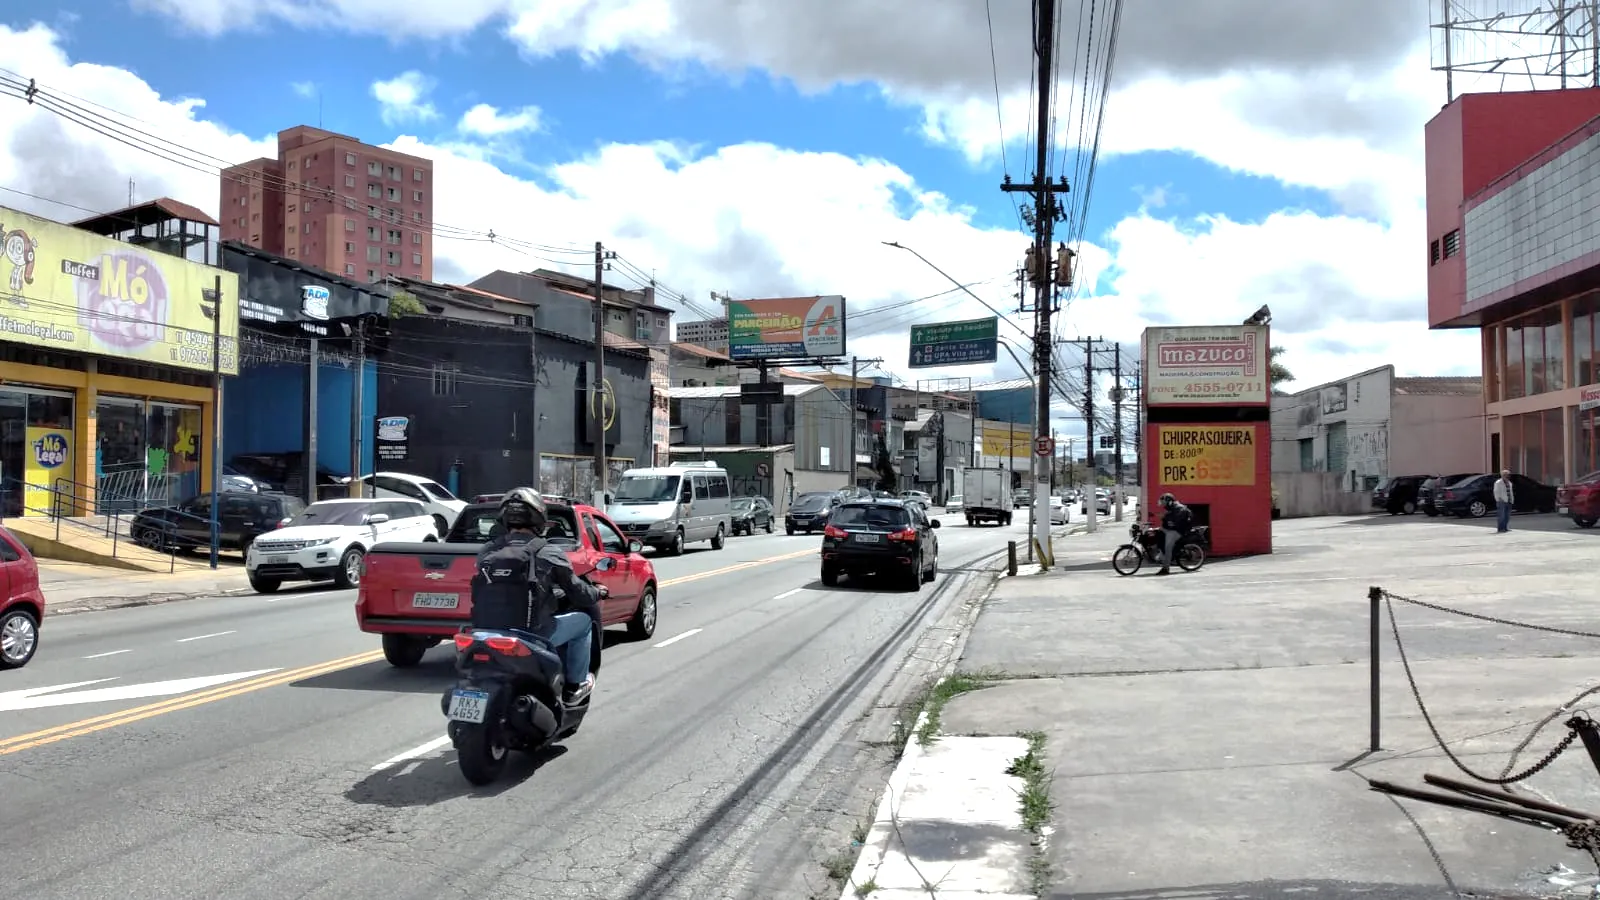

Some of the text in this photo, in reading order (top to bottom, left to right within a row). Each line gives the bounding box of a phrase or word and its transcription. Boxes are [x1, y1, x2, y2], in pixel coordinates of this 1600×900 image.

[64, 261, 97, 278] Buffet
[99, 254, 148, 305] Mó
[934, 351, 950, 359] UPA
[1163, 348, 1245, 362] mazuco
[1184, 382, 1262, 393] 4555-0711
[42, 435, 60, 452] Mó
[1163, 431, 1252, 446] CHURRASQUEIRA
[36, 446, 67, 465] Legal
[434, 598, 456, 606] 7738
[459, 697, 480, 708] RKX
[453, 707, 480, 720] 4G52
